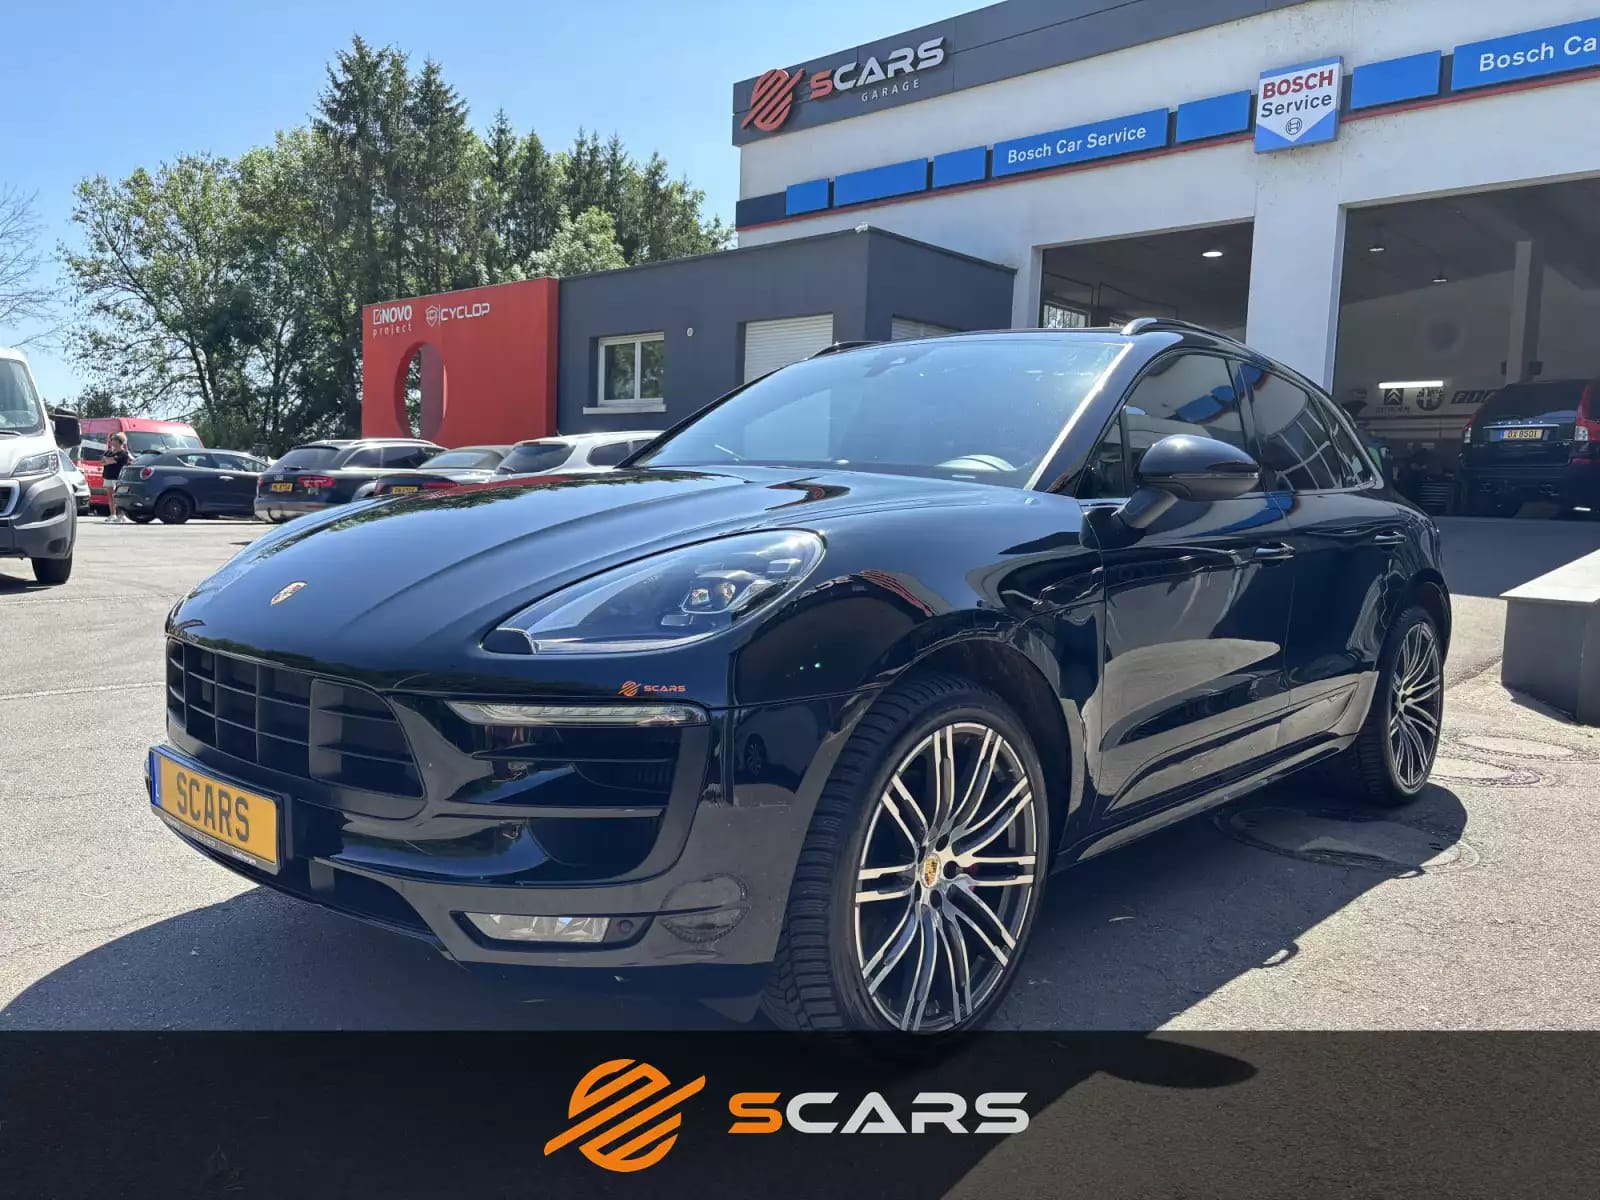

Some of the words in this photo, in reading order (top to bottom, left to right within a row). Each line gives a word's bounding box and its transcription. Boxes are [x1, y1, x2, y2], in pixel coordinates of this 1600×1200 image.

[809, 36, 945, 99] SCARS
[1480, 42, 1554, 72] Bosch
[861, 78, 921, 102] GARAGE
[1262, 69, 1334, 99] BOSCH
[1260, 94, 1332, 118] Service
[1007, 143, 1052, 164] Bosch
[1056, 139, 1083, 155] Car
[1087, 127, 1147, 149] Service
[440, 302, 490, 321] CYCLOP
[373, 322, 412, 339] project
[177, 771, 249, 842] SCARS
